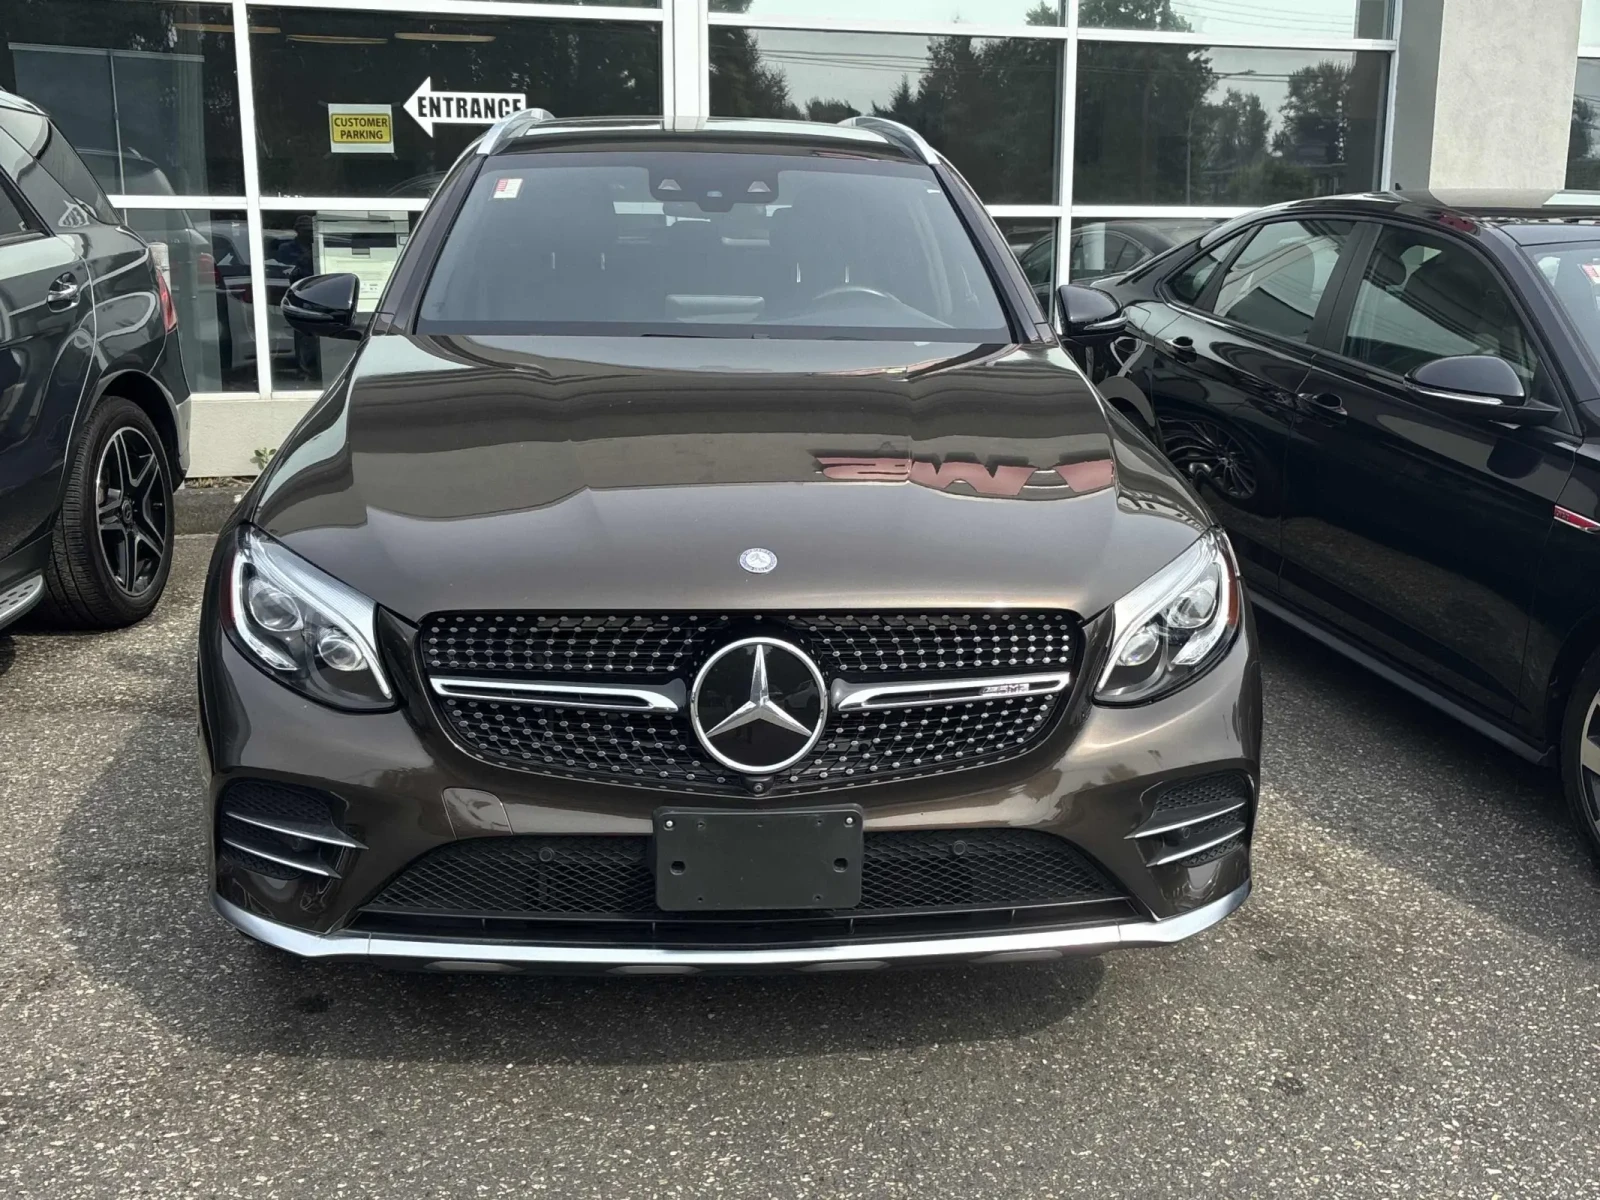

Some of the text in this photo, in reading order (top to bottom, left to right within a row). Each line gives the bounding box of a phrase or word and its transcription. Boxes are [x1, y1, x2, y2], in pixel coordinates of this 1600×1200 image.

[416, 96, 522, 119] ENTRANCE
[334, 117, 388, 127] CUSTOMER
[340, 130, 383, 140] PARKING
